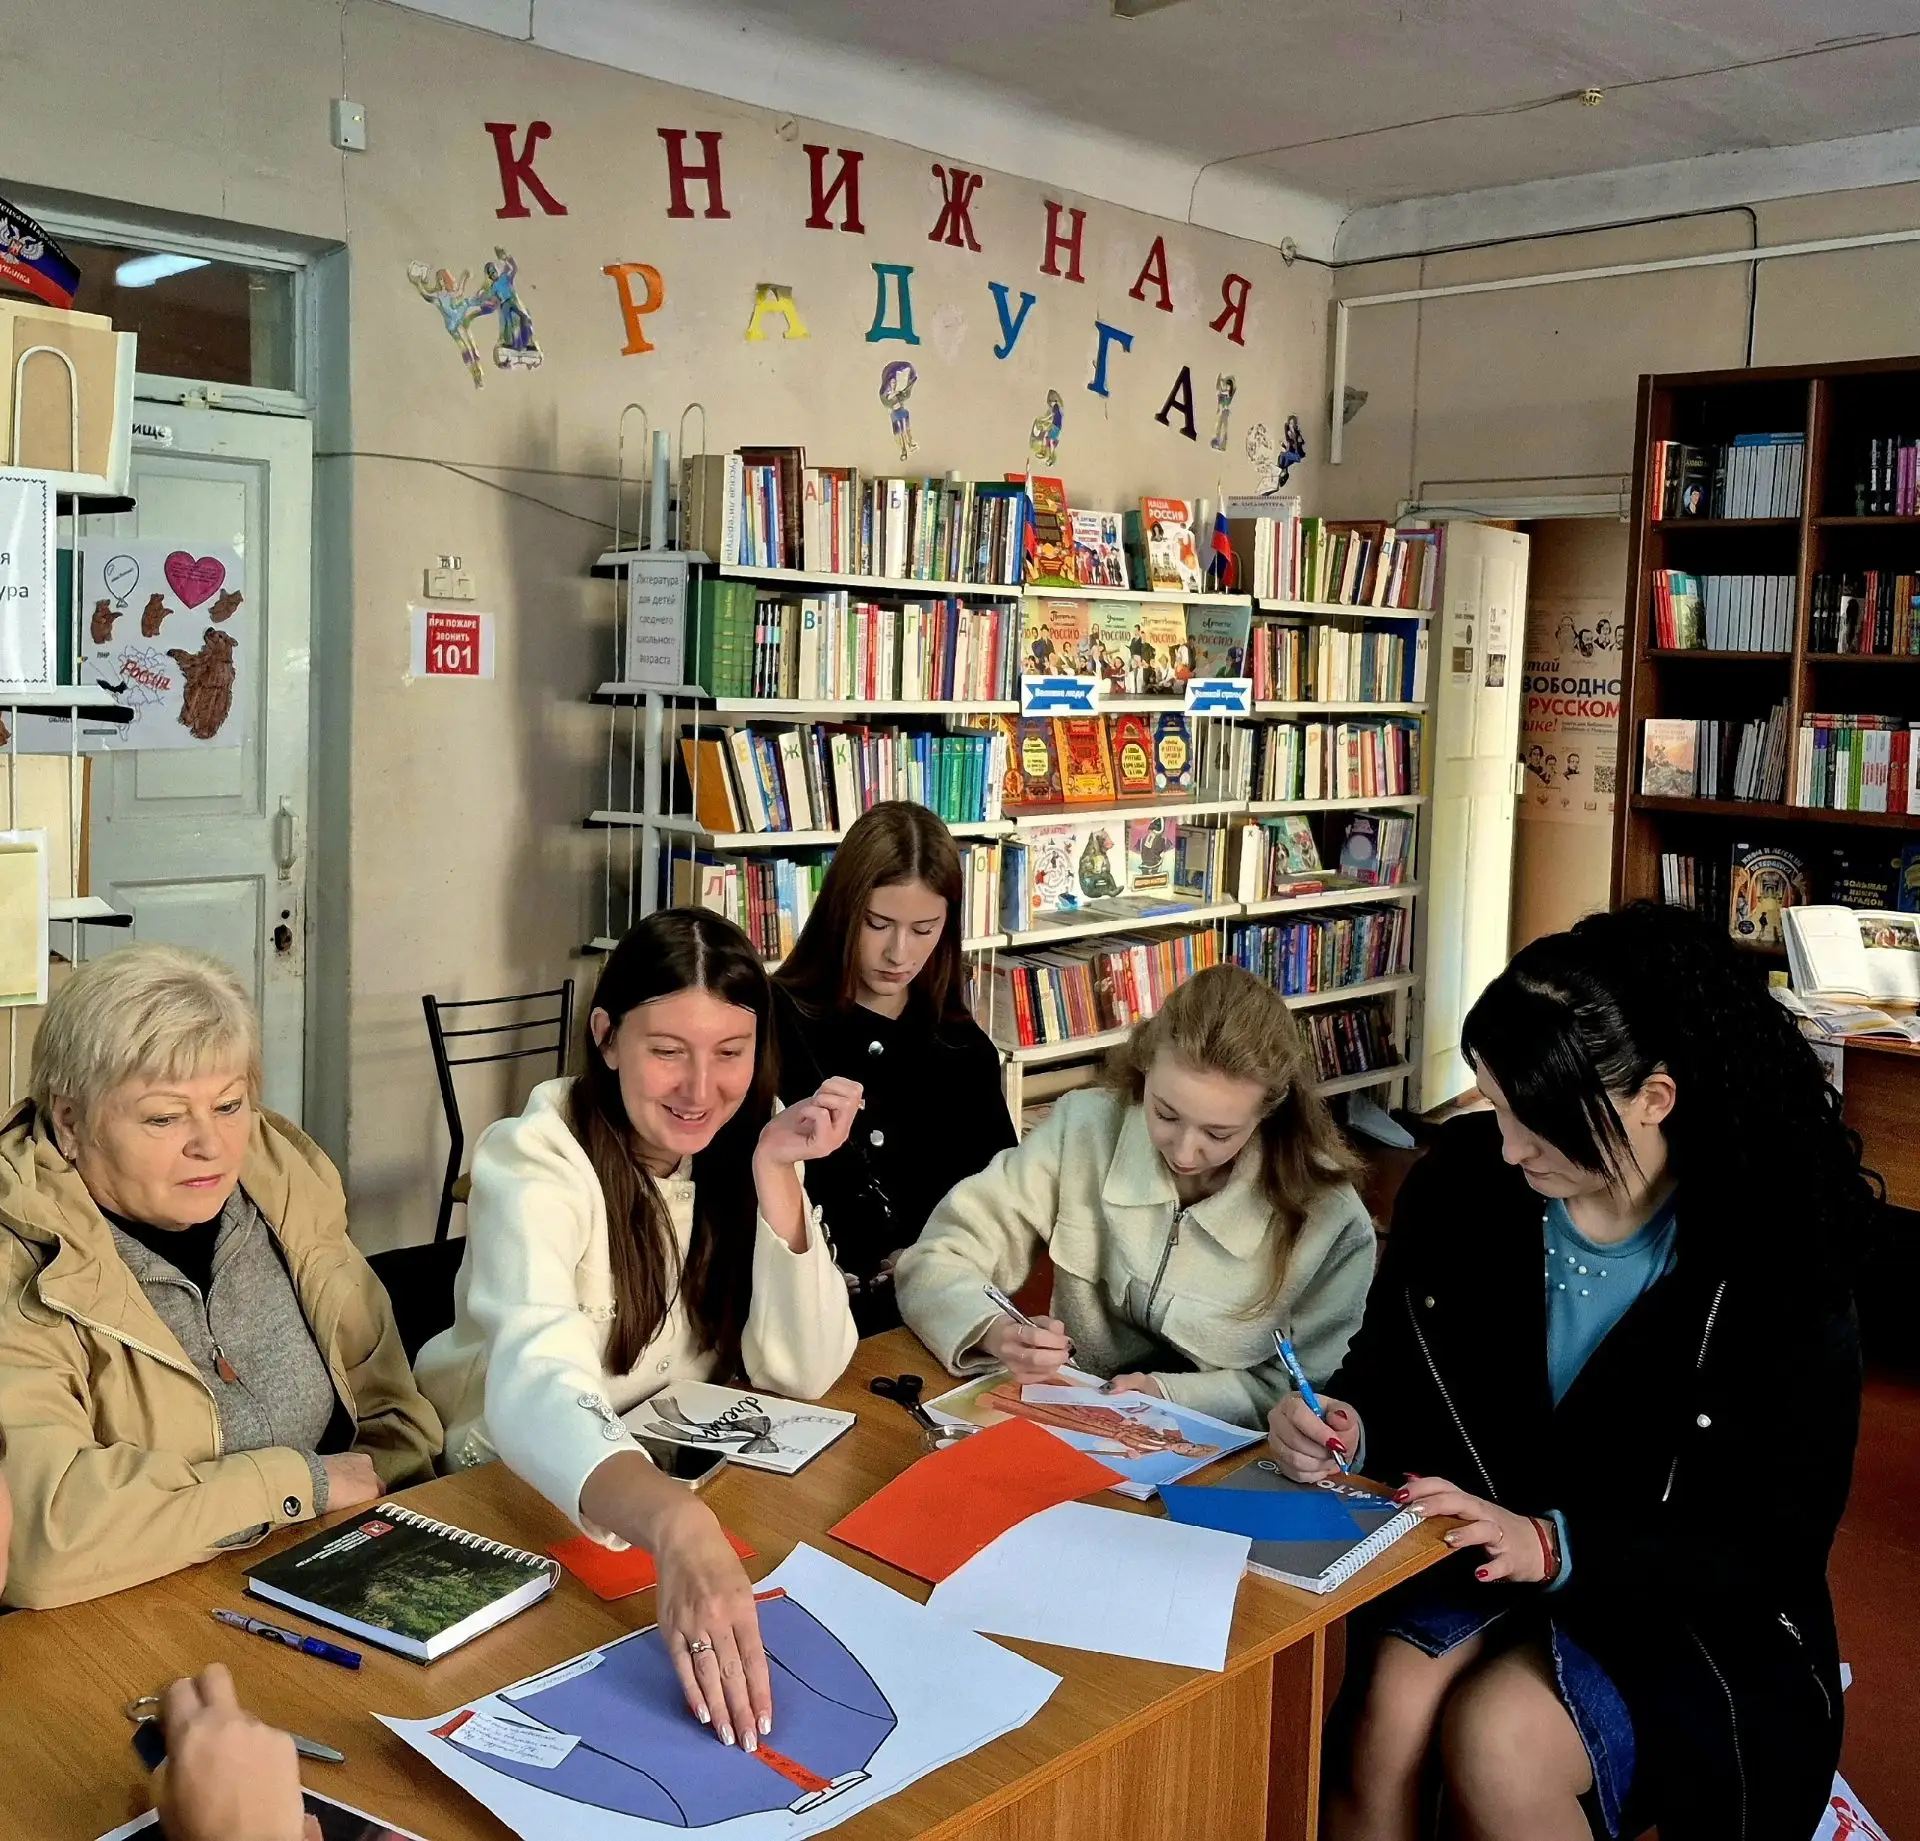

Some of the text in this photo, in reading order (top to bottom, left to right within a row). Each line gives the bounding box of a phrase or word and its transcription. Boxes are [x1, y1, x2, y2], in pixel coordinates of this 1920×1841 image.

[484, 121, 1253, 347] КНИЖНАЯ
[602, 261, 1198, 441] РАДУГА
[804, 481, 816, 500] А
[890, 490, 901, 509] Б
[1149, 509, 1186, 521] РОССИЯ
[652, 595, 676, 606] детей
[429, 617, 477, 629] ПРИ ПОЖАРЕ
[804, 610, 815, 630] В
[436, 631, 470, 642] ЗВОНИТЬ
[1417, 639, 1427, 650] М
[432, 643, 472, 669] 101
[1528, 697, 1622, 718] РУССКОМ
[1309, 731, 1318, 746] Р
[784, 744, 801, 761] Ж
[836, 745, 847, 764] К
[704, 875, 723, 896] Л
